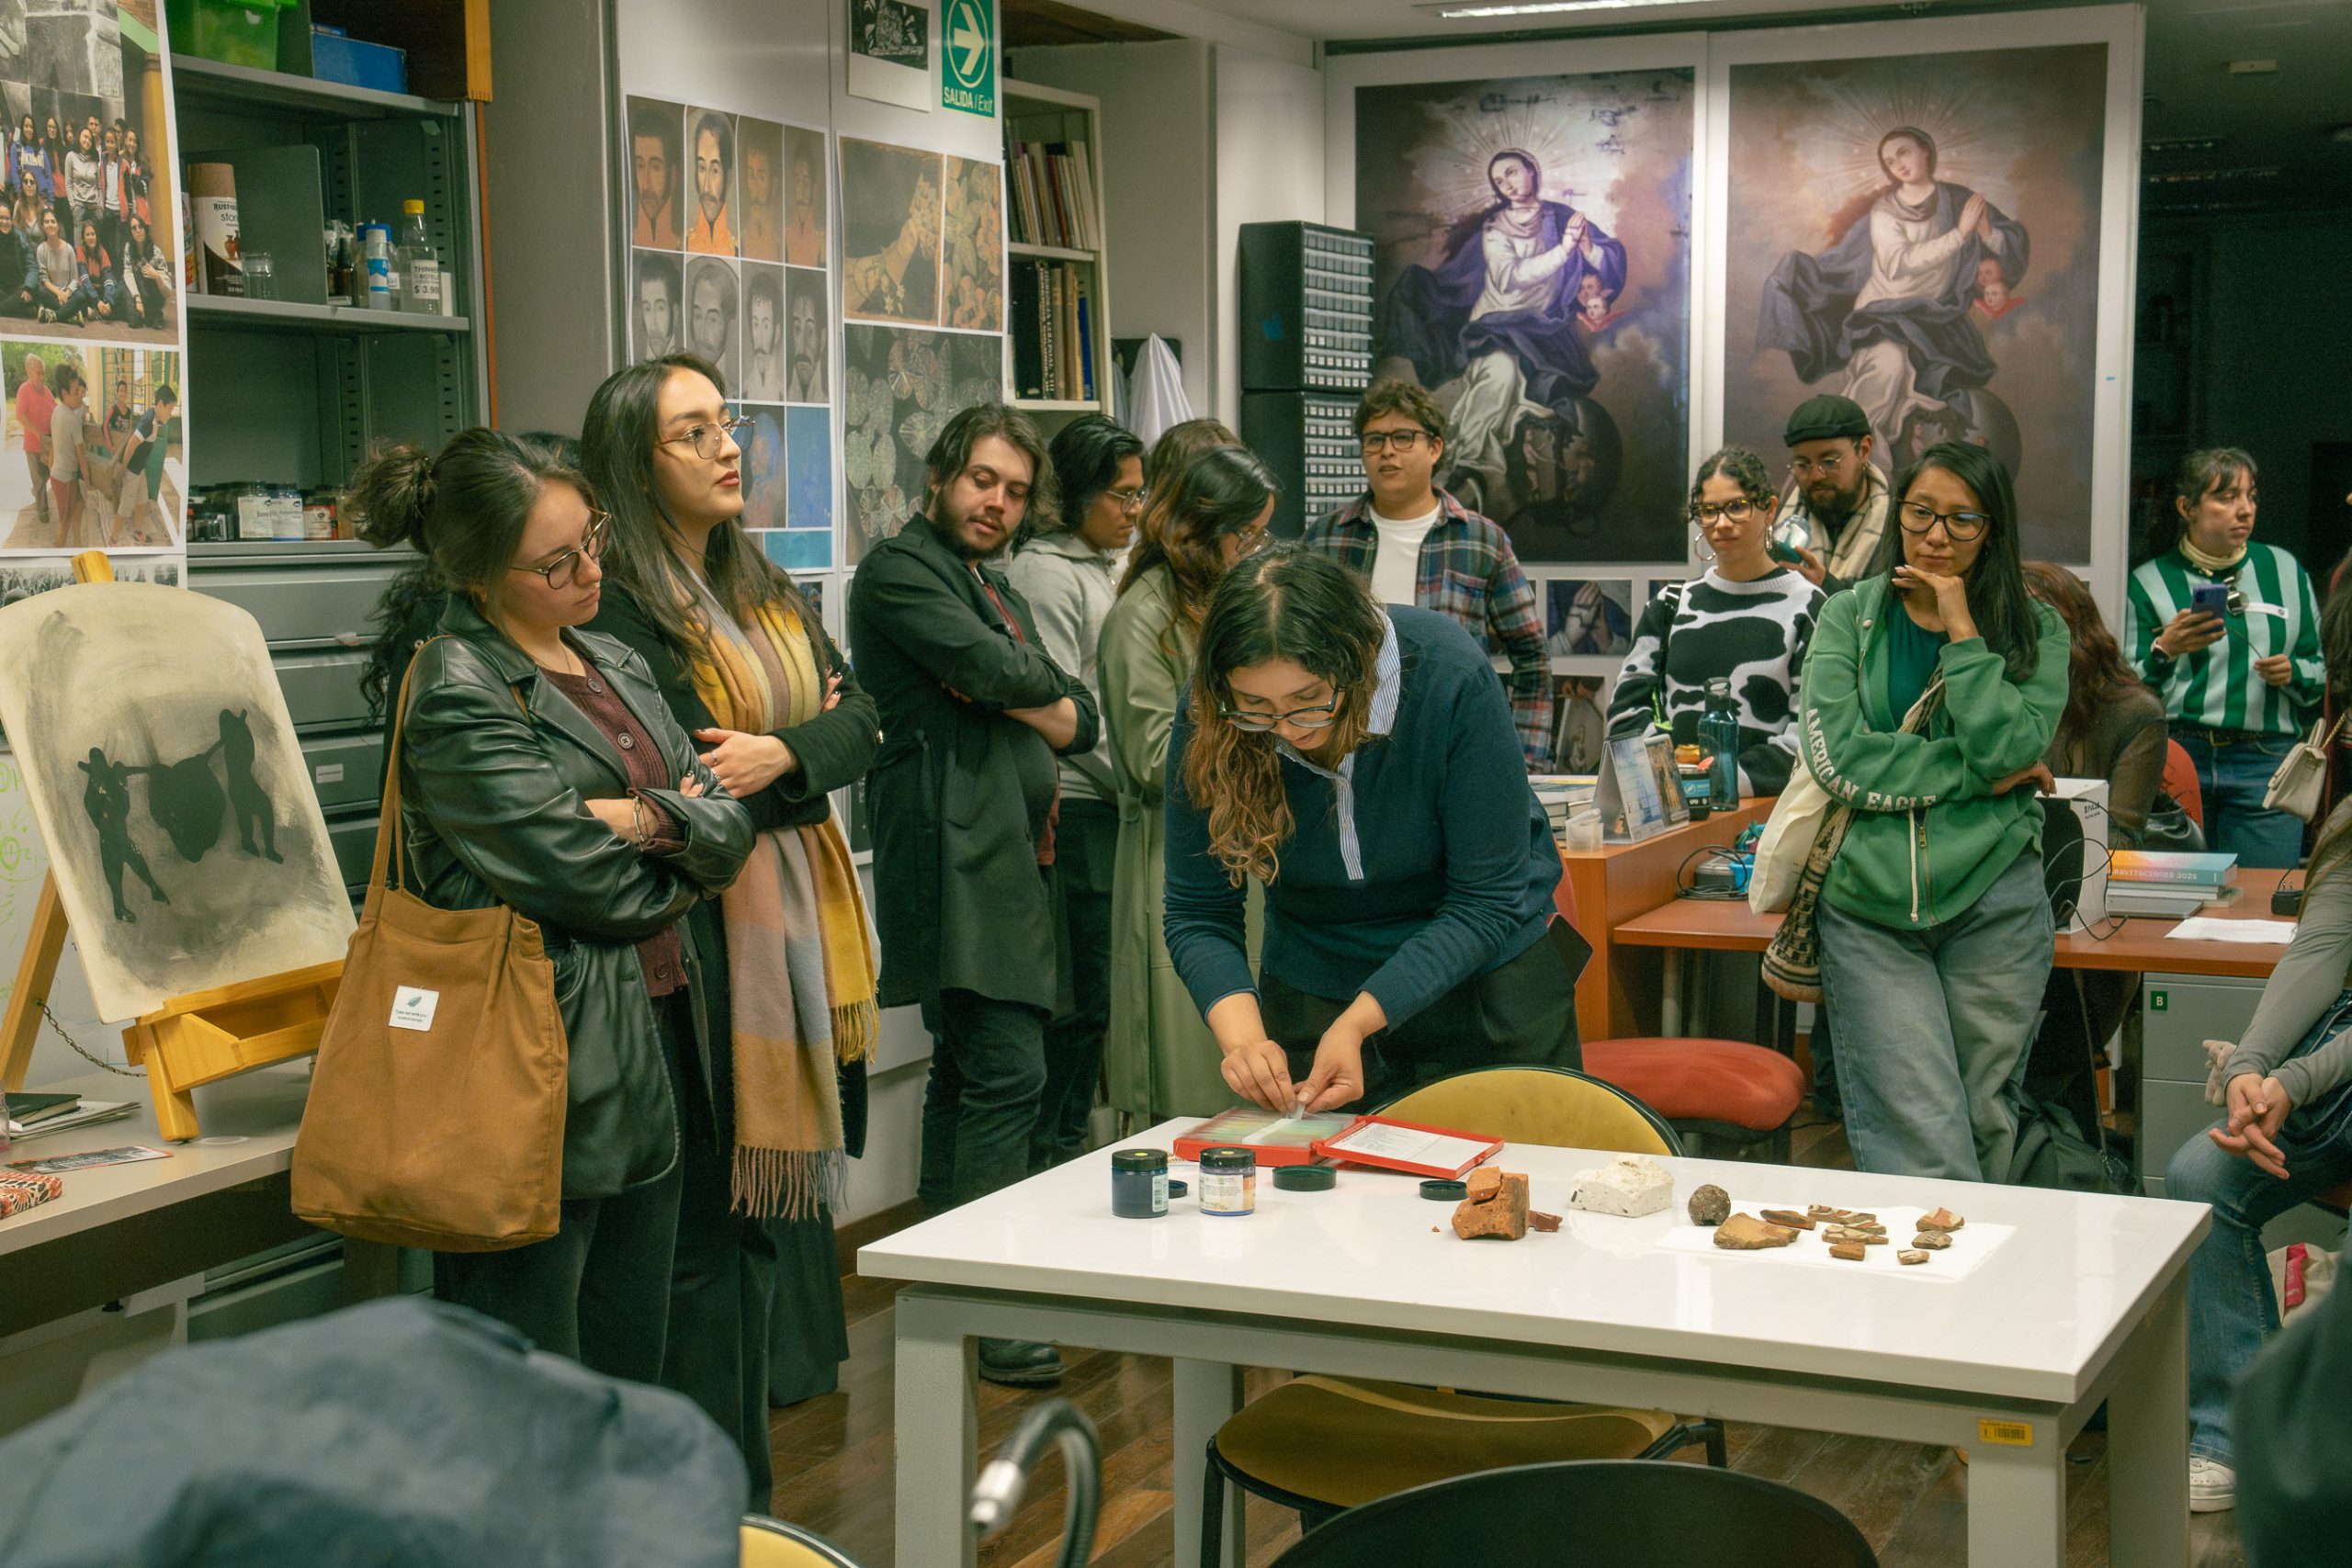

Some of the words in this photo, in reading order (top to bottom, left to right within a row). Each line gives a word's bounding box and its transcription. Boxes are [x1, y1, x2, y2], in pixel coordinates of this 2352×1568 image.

[944, 86, 974, 108] SALIDA
[1806, 708, 1860, 802] AMERICAN
[2156, 996, 2164, 1007] B
